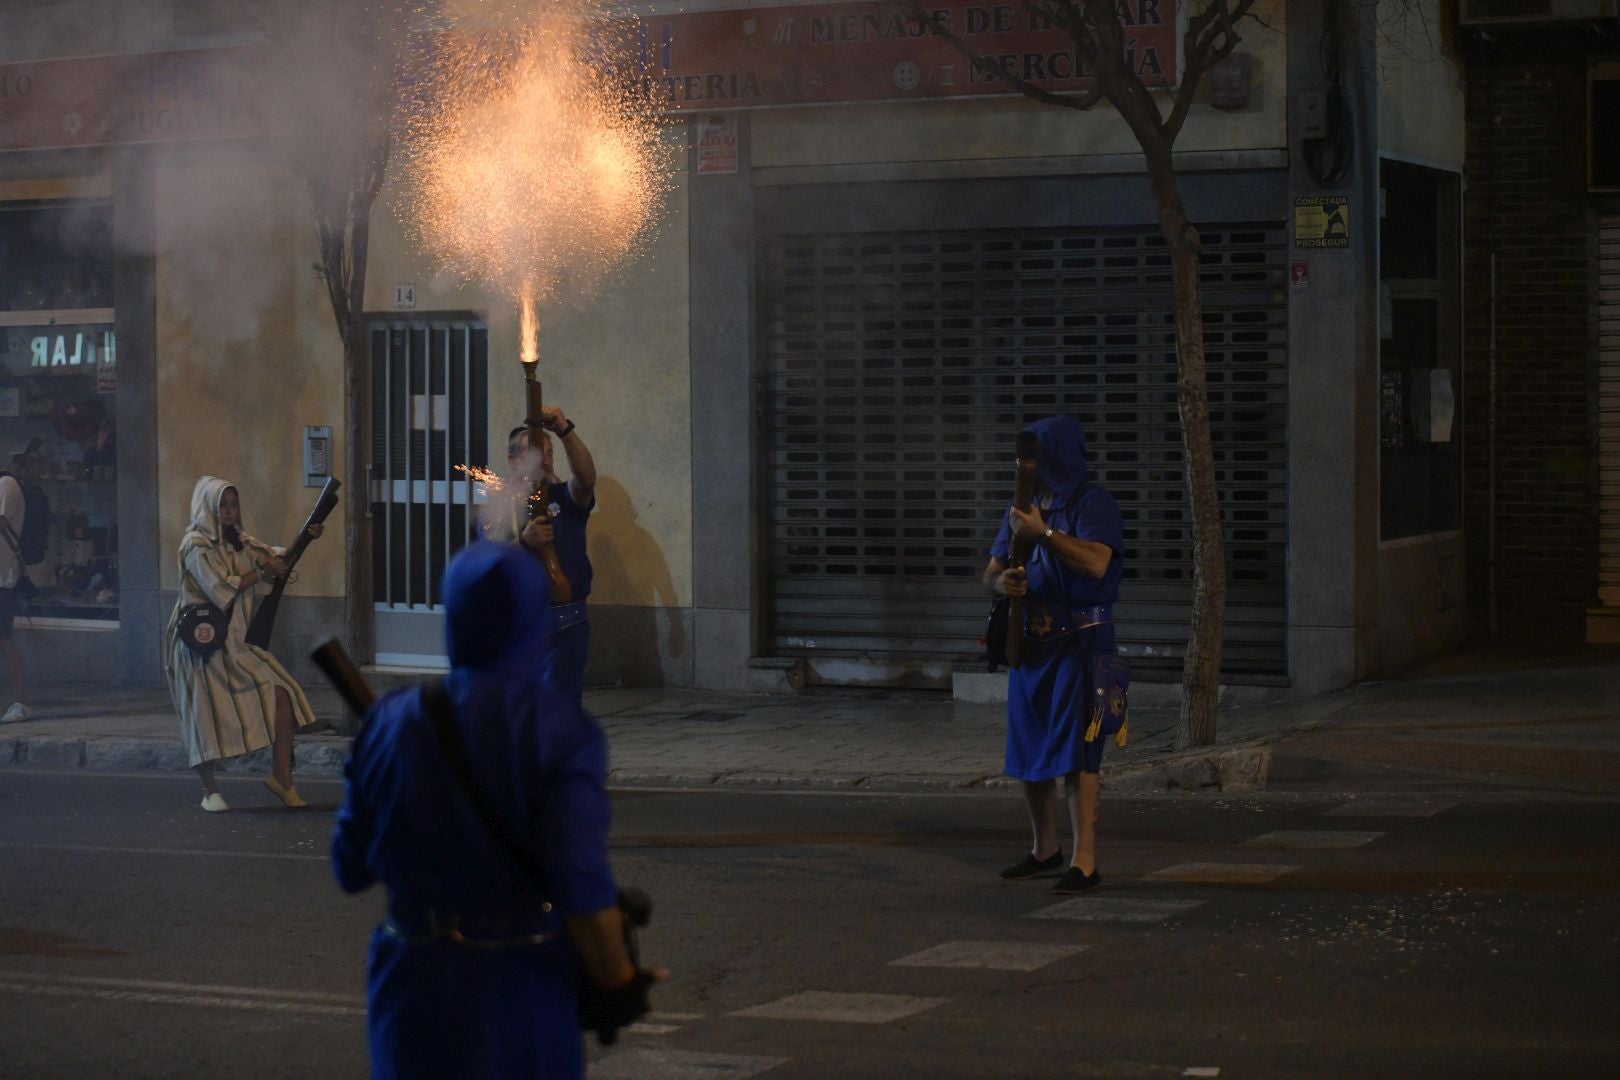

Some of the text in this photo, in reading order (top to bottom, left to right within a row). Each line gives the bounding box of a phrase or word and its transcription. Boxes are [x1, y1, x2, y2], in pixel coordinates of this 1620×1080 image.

[811, 0, 1162, 43] MENAJE DE HAR
[969, 37, 1163, 84] MERCEÍA
[1295, 196, 1348, 206] CONECTADA
[1295, 238, 1348, 247] PROSEGUR
[396, 288, 413, 302] 14
